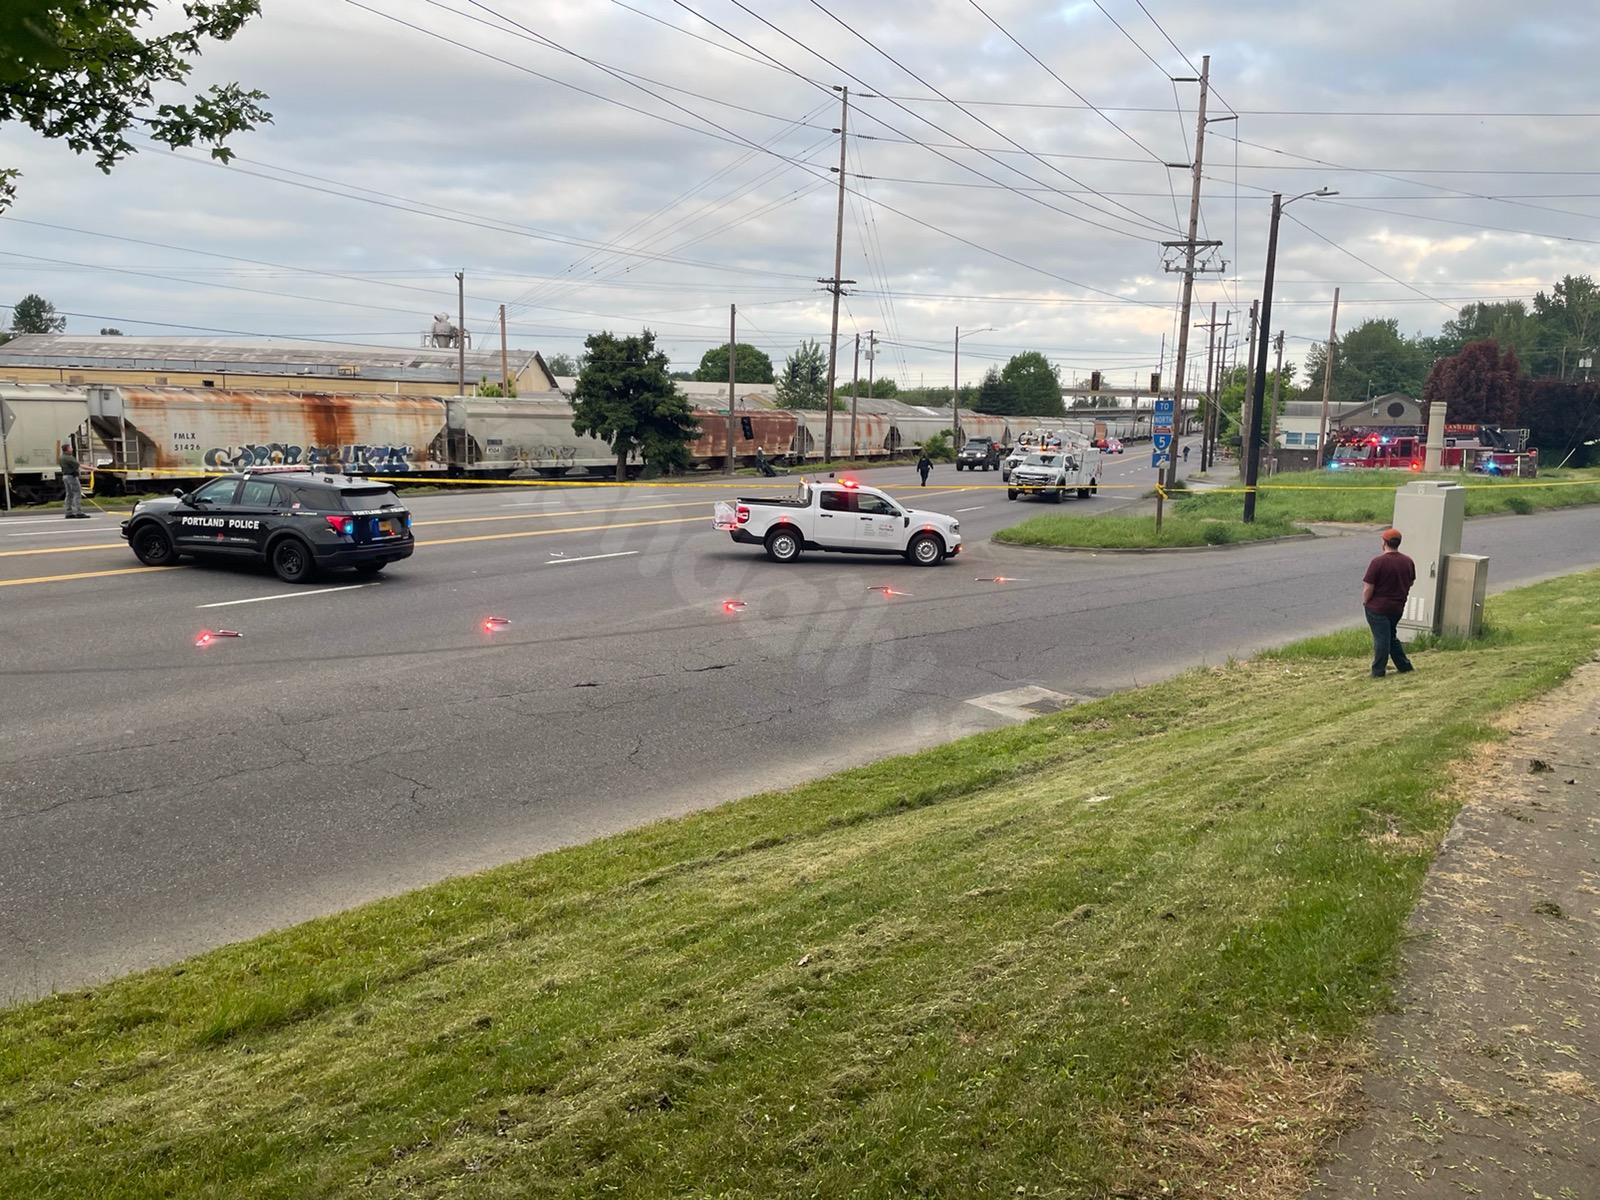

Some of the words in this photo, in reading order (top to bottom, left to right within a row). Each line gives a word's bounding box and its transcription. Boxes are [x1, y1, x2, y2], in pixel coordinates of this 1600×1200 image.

[174, 432, 196, 440] FMLX
[1159, 436, 1166, 448] 5
[181, 516, 225, 528] PORTLAND
[228, 519, 260, 530] POLICE
